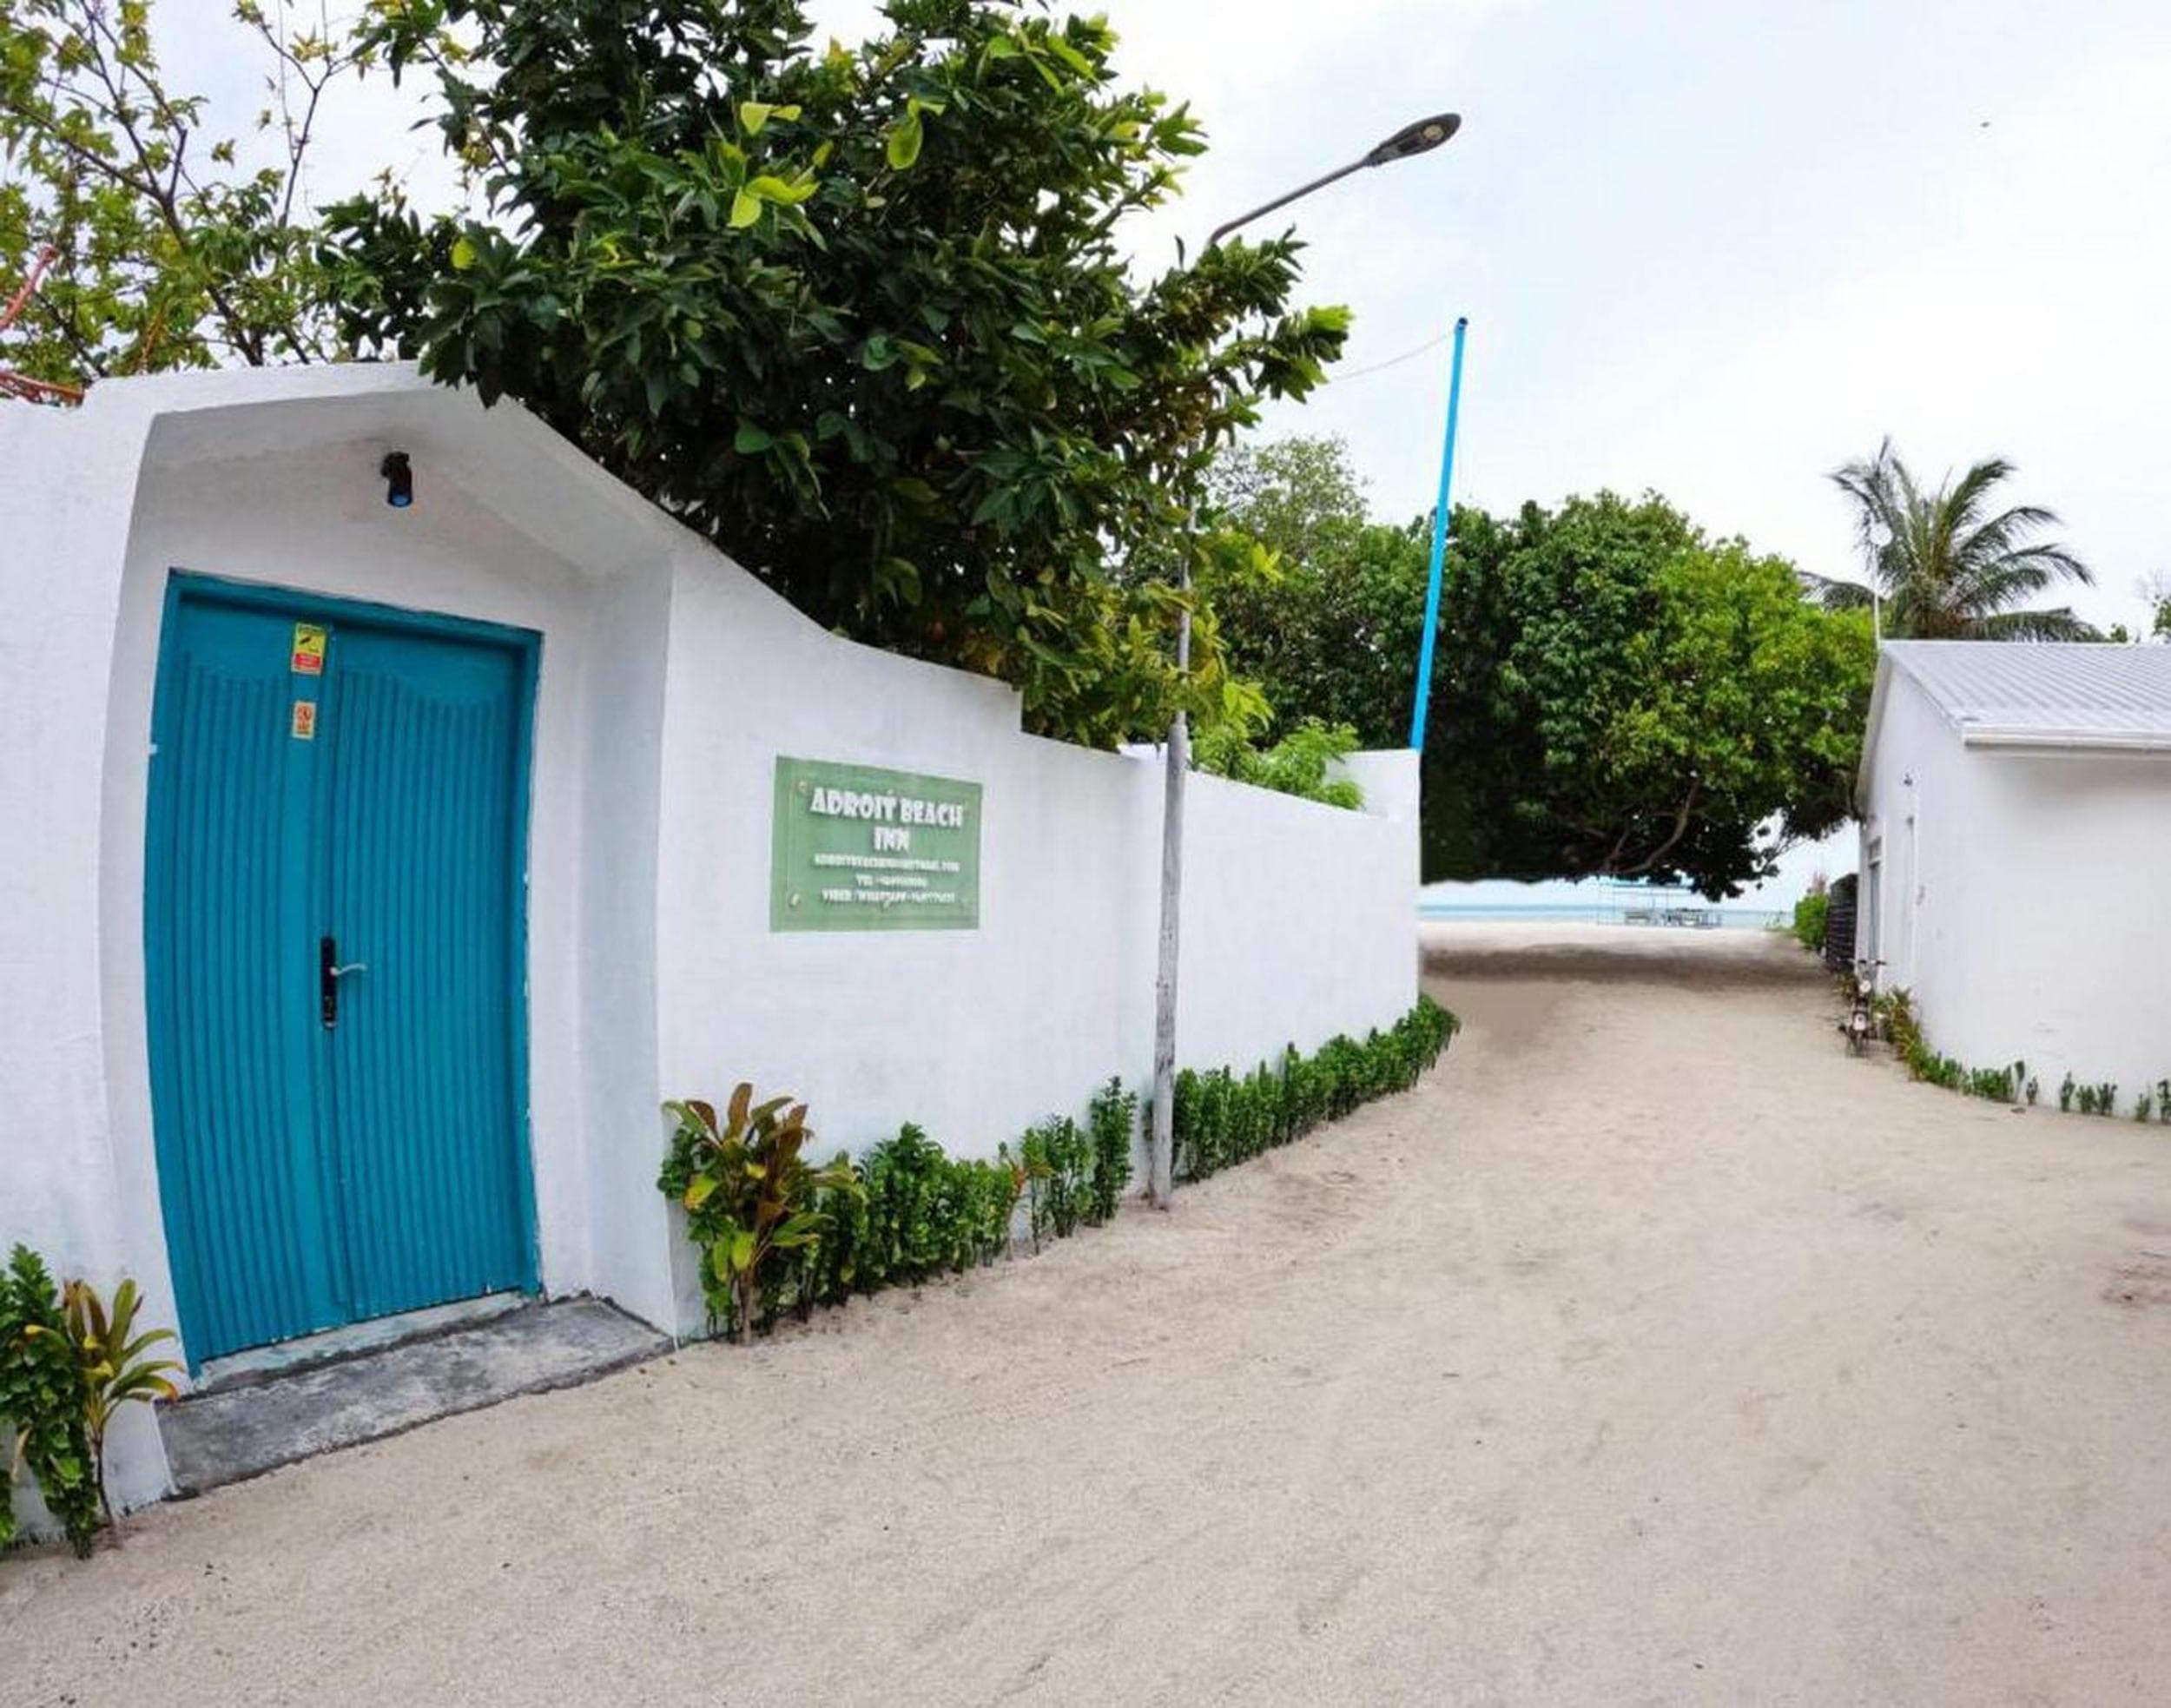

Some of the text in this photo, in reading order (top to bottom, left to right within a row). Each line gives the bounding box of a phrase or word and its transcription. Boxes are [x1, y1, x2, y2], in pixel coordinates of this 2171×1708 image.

[809, 787, 964, 828] ADROIT BEACH
[874, 826, 910, 851] INN
